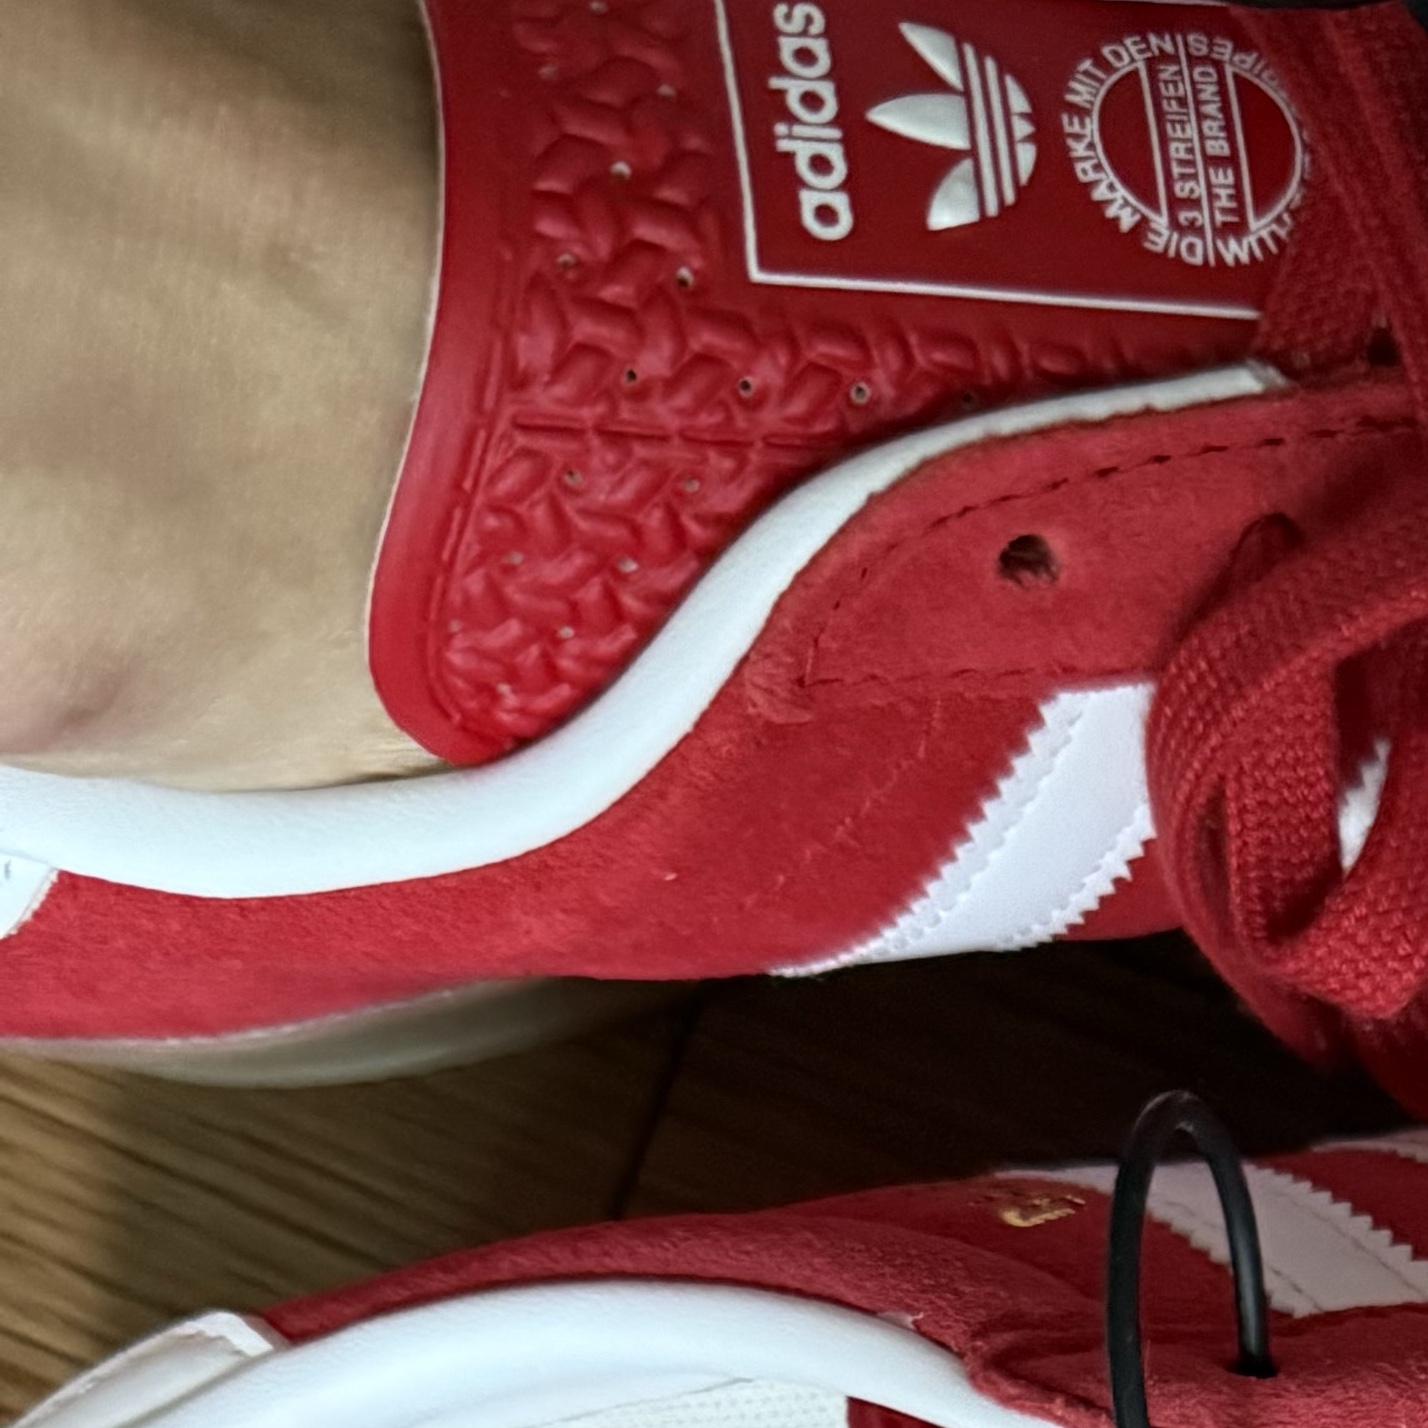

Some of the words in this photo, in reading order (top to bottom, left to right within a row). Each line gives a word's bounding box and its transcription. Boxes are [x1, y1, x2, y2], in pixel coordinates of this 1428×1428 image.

[1101, 33, 1175, 69] DEN
[1064, 58, 1107, 109] MIT
[1193, 66, 1230, 157] BRAND
[768, 3, 853, 241] adidas
[1158, 64, 1200, 200] STREIFEN
[1061, 112, 1141, 233] MARKE
[1209, 167, 1240, 227] THE
[1143, 220, 1203, 265] DIE
[1178, 210, 1203, 227] 3
